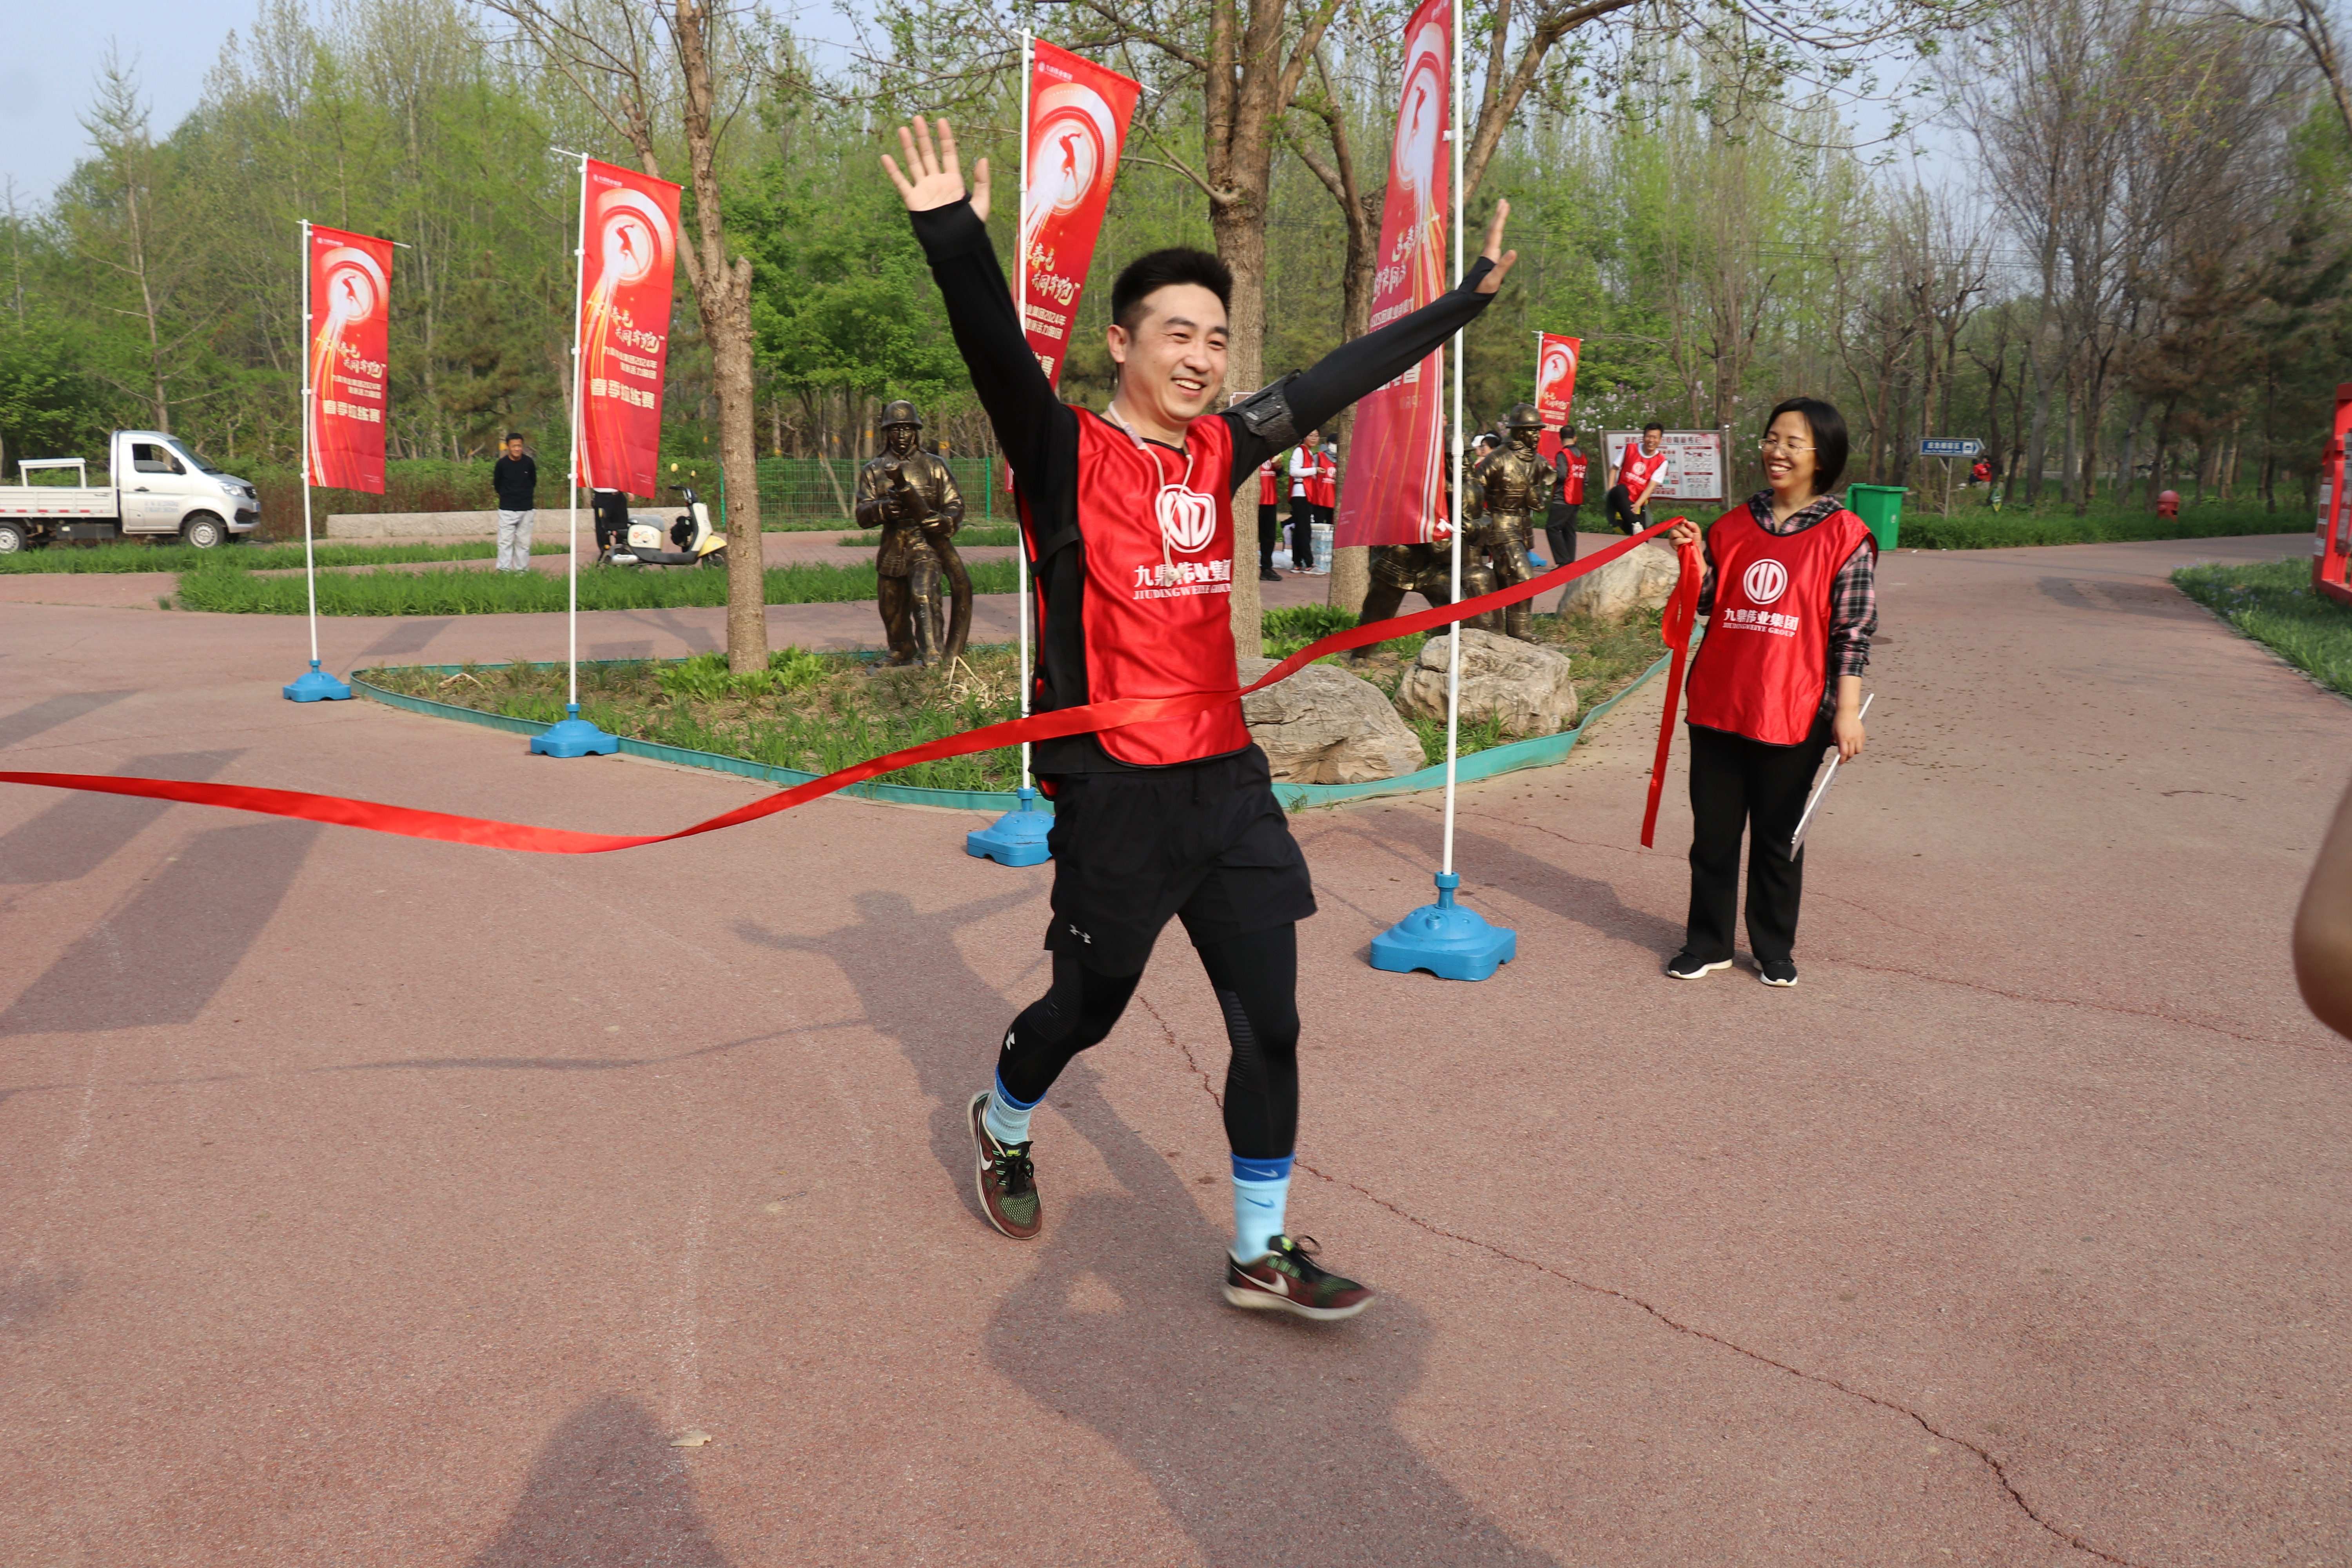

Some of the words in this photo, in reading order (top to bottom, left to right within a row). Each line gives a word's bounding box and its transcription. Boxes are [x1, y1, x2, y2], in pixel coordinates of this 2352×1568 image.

[591, 378, 655, 409] 春季拉练赛
[323, 400, 380, 423] 春季拉练赛
[1724, 608, 1799, 631] 九鼎伟业集团
[1768, 627, 1795, 637] GROUP
